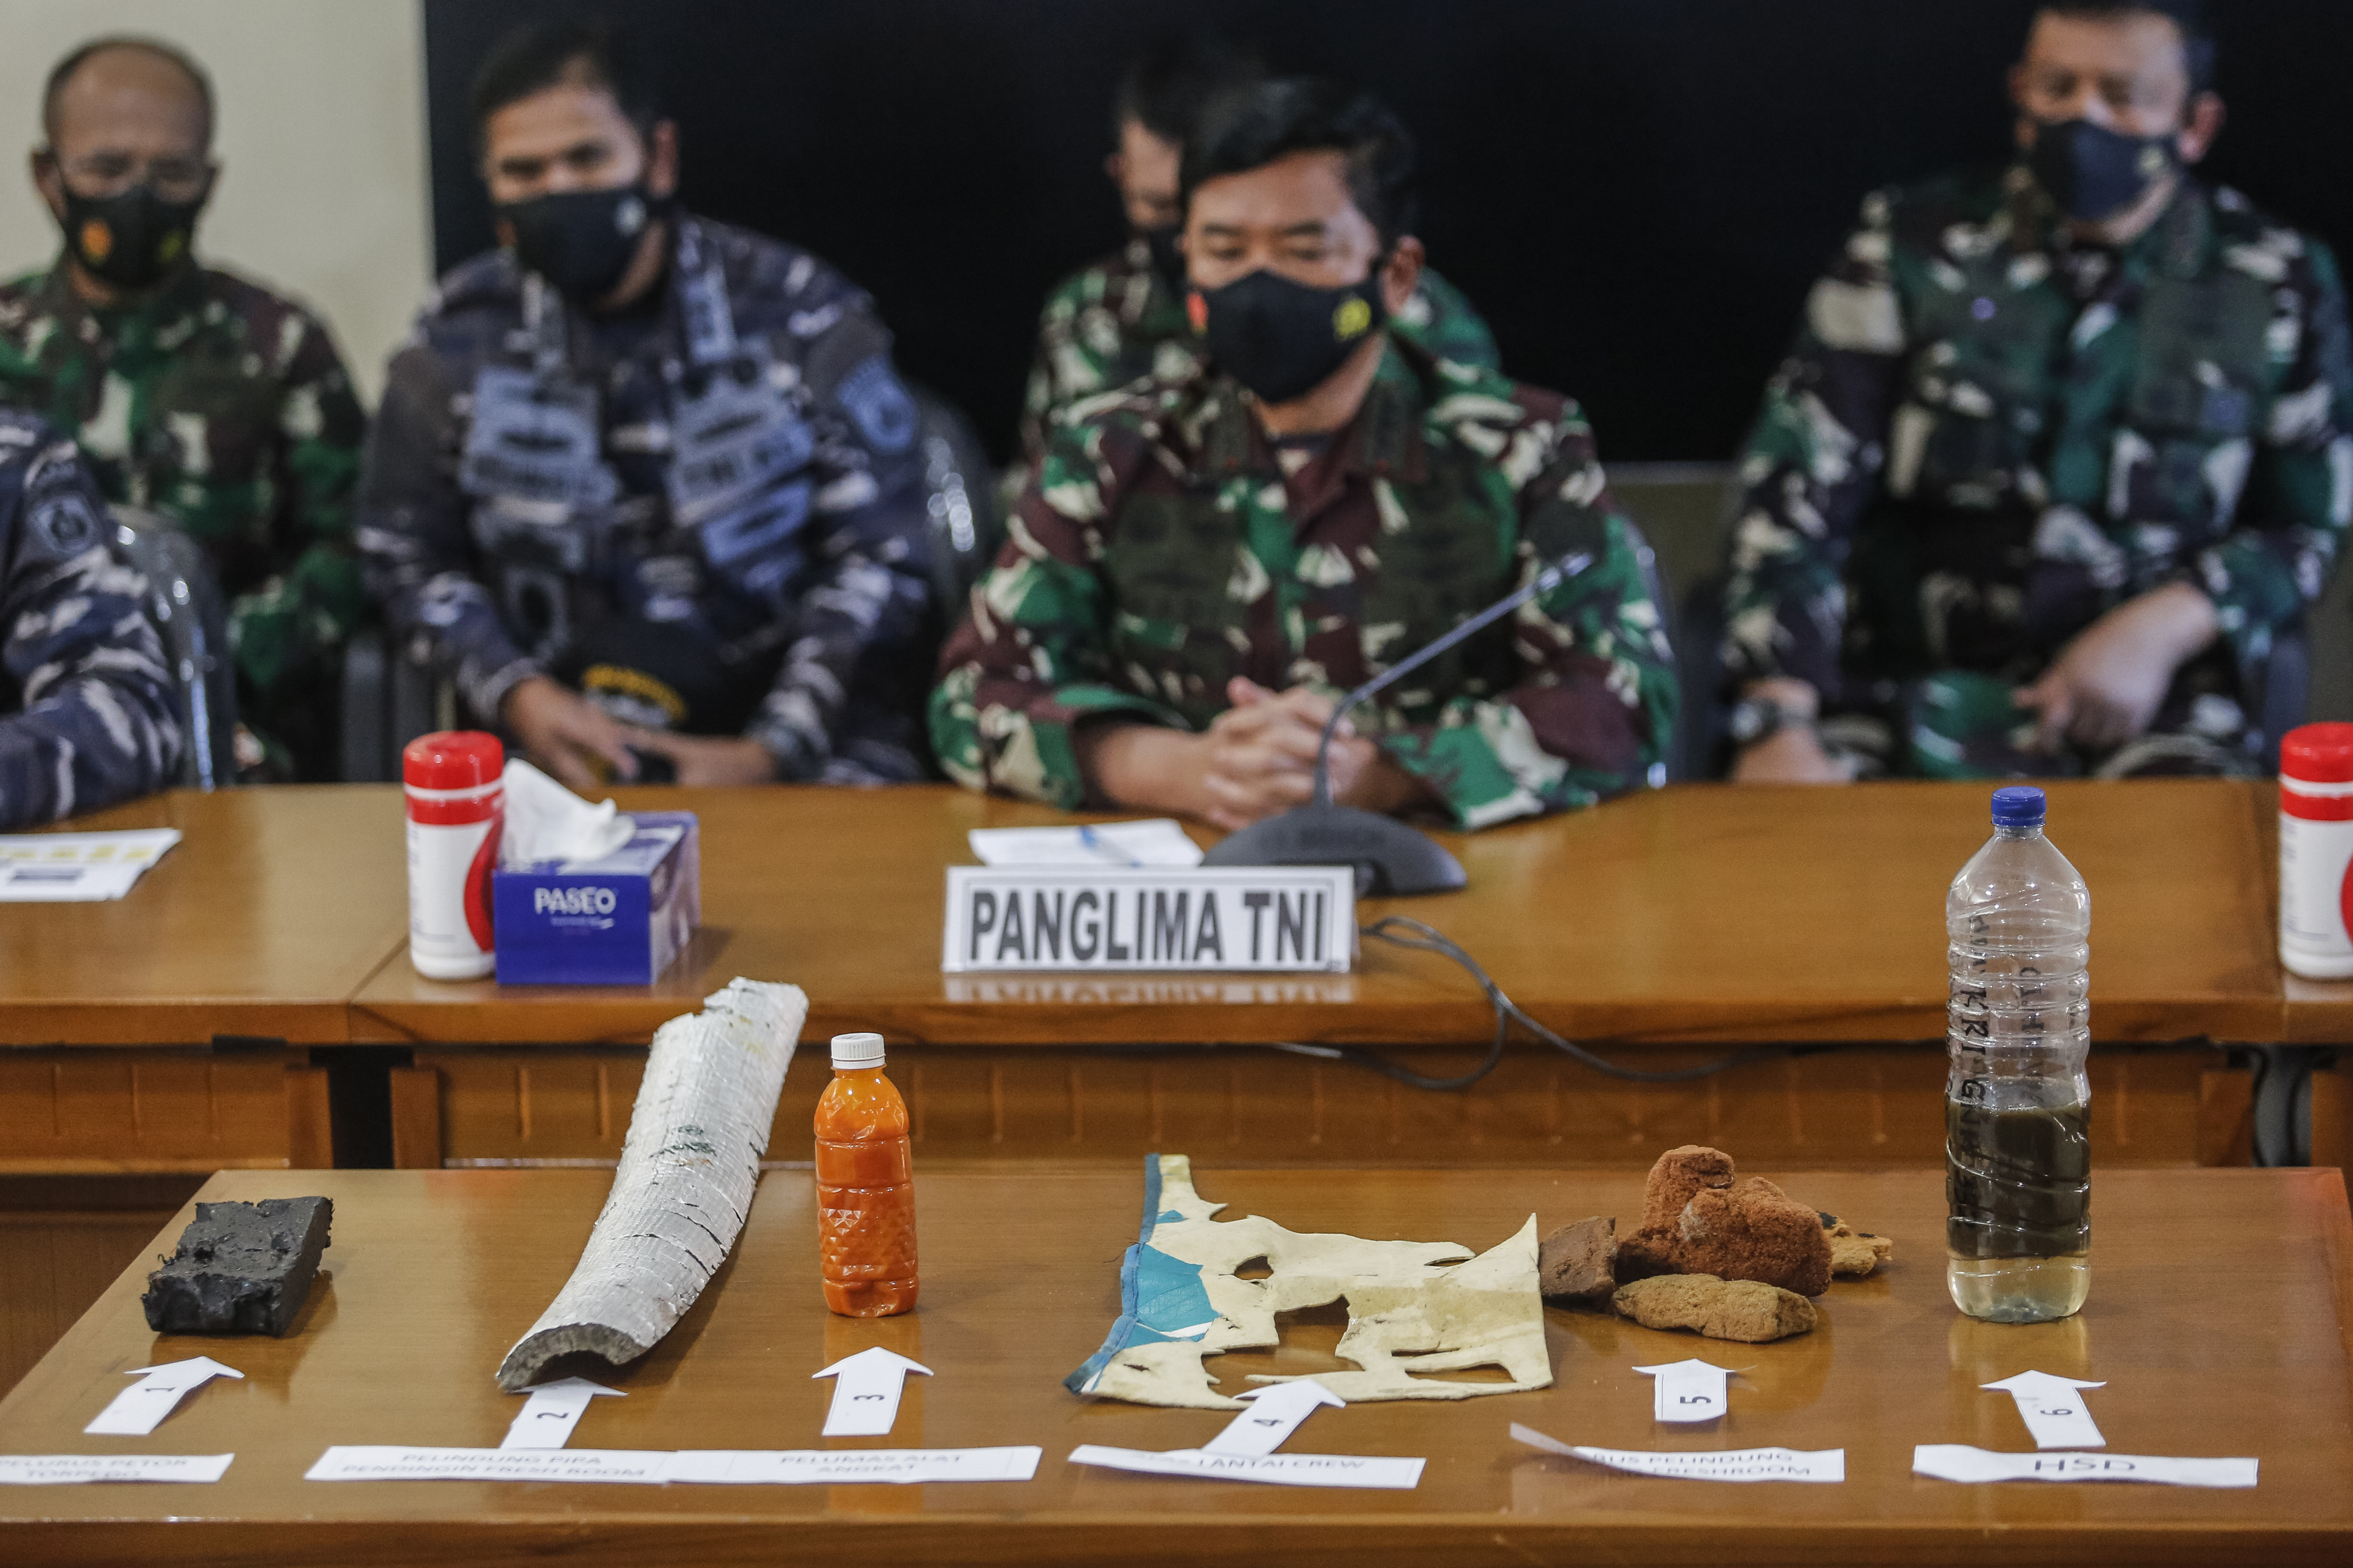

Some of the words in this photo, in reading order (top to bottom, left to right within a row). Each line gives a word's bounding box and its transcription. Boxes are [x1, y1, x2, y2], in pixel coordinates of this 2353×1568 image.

[534, 886, 616, 915] PASEO
[969, 890, 1224, 961] PANGLIMA
[1244, 891, 1325, 961] TNI
[1679, 1395, 1712, 1404] 5
[1252, 1418, 1285, 1427] 4
[401, 1454, 543, 1464] PELINDUNG
[549, 1456, 602, 1464] PIPA
[1292, 1458, 1366, 1469] CREW
[1649, 1452, 1793, 1464] PELINDUNG
[2034, 1457, 2136, 1471] HSD
[342, 1464, 478, 1473] PENDINGIN
[485, 1465, 561, 1475] FRESH
[565, 1468, 647, 1477] ROOM
